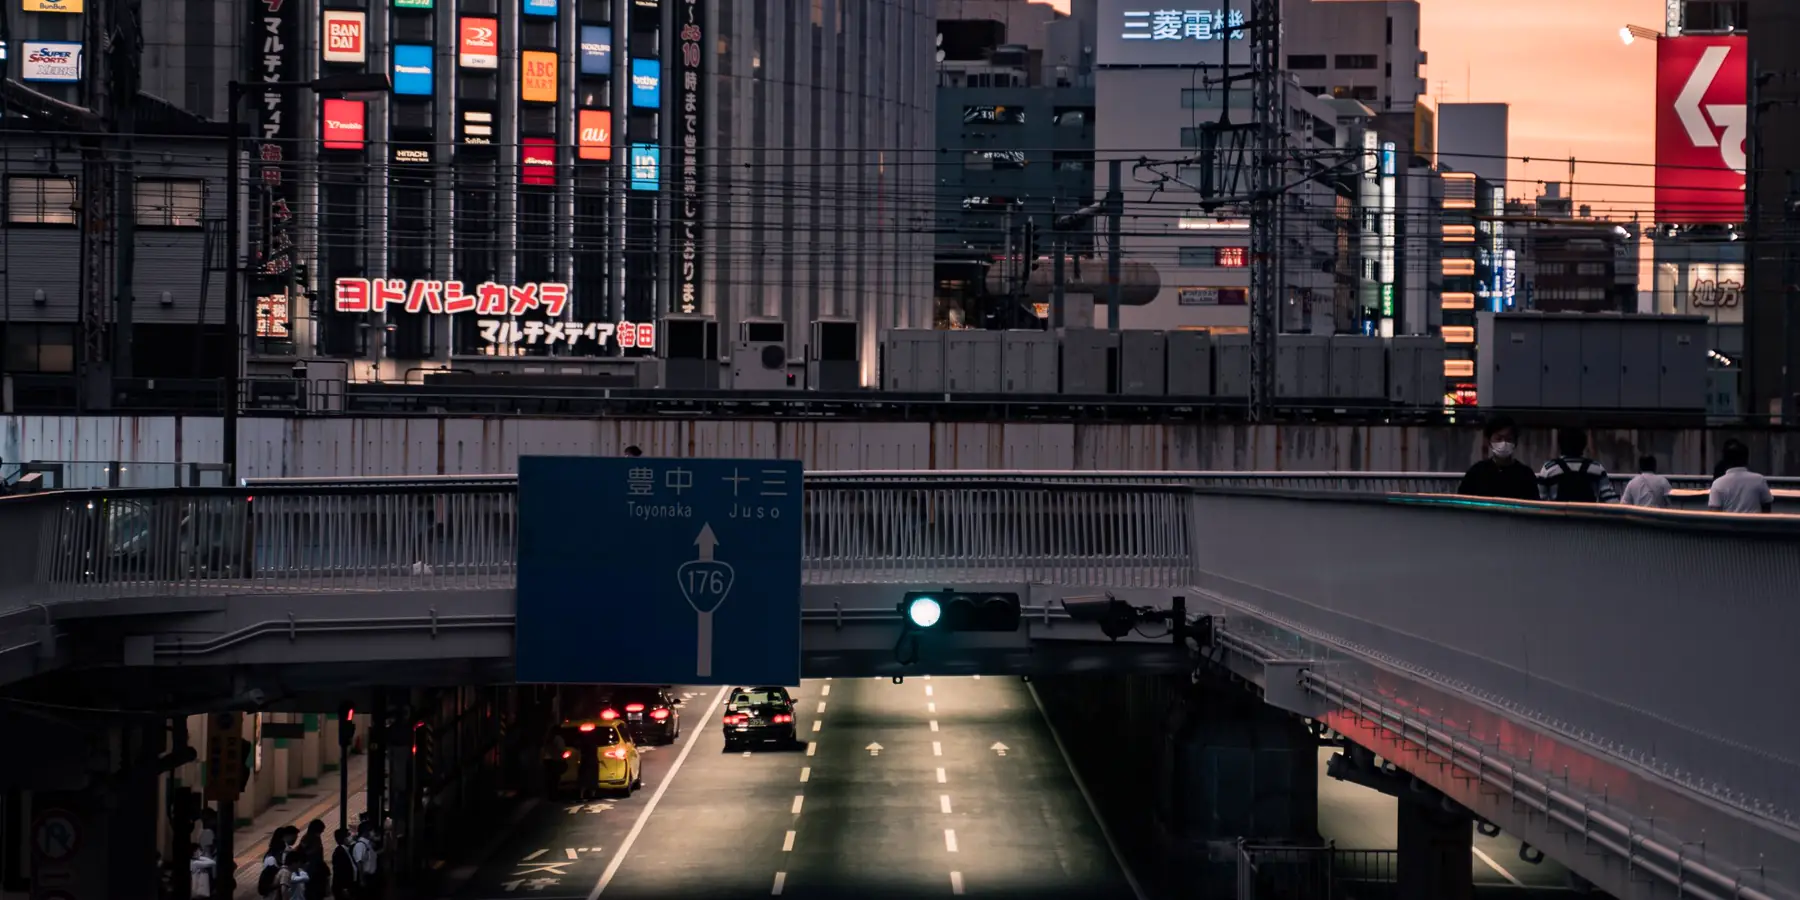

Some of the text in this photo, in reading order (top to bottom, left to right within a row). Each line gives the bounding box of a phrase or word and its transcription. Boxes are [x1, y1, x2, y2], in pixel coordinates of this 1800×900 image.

[330, 24, 359, 36] BAN
[1121, 9, 1244, 40] 三菱電機
[330, 36, 354, 48] DAI
[29, 54, 68, 63] SPORTS
[39, 48, 71, 57] SUPER
[527, 61, 554, 77] ABC
[526, 78, 554, 89] MART
[582, 128, 609, 142] au
[397, 151, 428, 159] HITACHI
[335, 278, 568, 317] ヨドバシカメラ
[477, 319, 654, 348] マルチメディア梅田
[627, 467, 788, 496] 豊中 十三
[627, 501, 780, 520] Toyonaka Juso
[687, 570, 724, 594] 176
